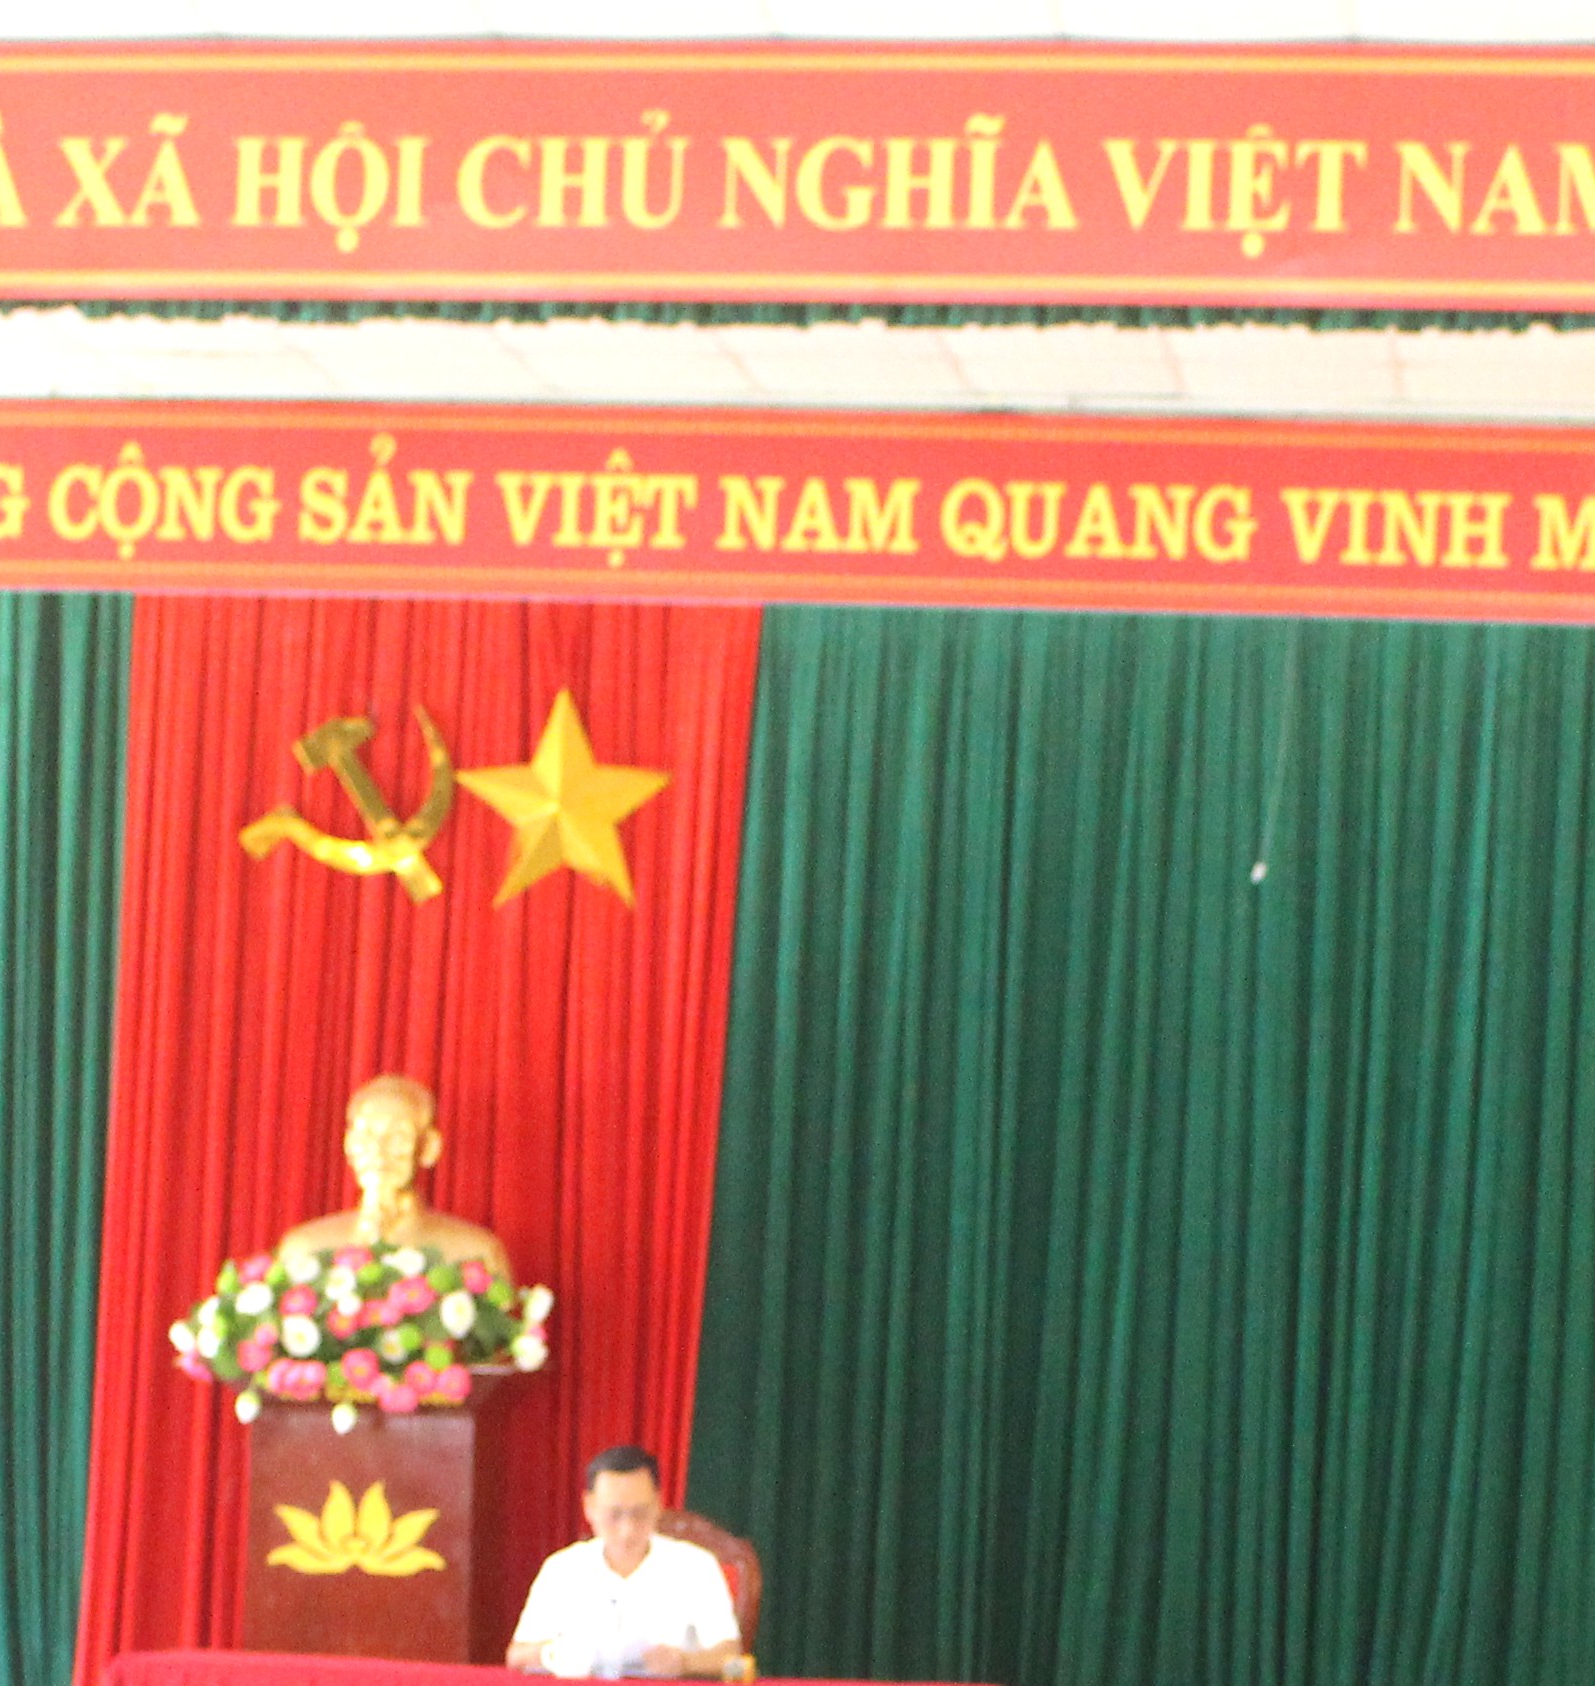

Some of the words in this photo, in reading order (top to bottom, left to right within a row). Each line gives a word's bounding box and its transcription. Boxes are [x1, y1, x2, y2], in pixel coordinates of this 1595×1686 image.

[53, 111, 202, 229] XÃ
[230, 120, 428, 255] HỘI
[455, 108, 690, 231] CHỦ
[718, 112, 1079, 232] NGHĨA
[1103, 122, 1368, 260] VIỆT
[46, 440, 282, 565] CỘNG
[297, 432, 474, 546] SẢN
[494, 448, 699, 571] VIỆT
[714, 474, 921, 555] NAM
[939, 477, 1258, 564] QUANG
[1280, 487, 1512, 570] VINH
